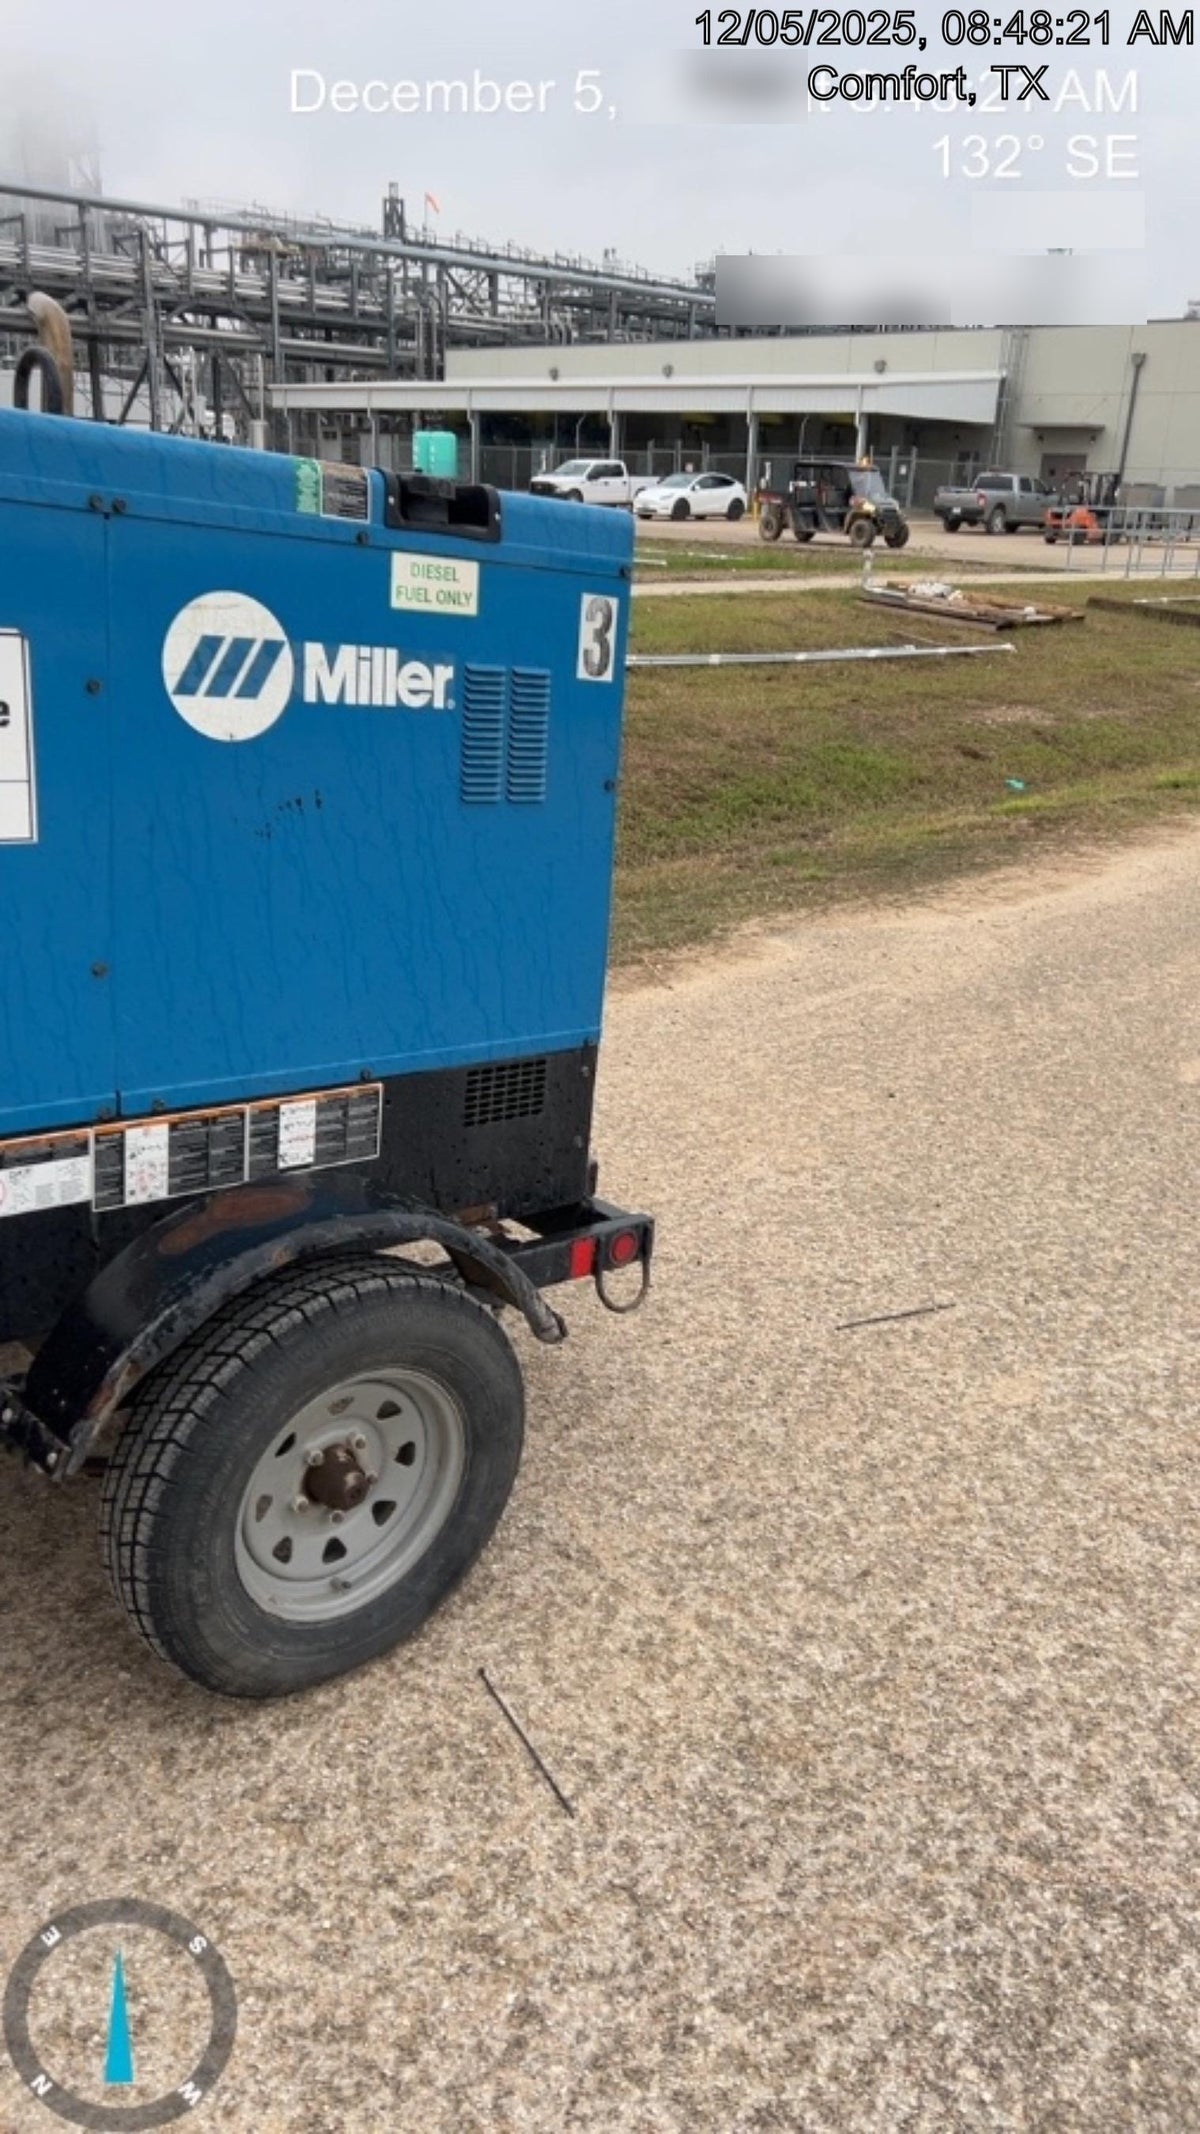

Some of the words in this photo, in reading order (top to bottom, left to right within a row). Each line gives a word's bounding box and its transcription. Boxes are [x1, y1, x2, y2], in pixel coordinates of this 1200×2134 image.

[409, 562, 460, 582] DIESEL
[395, 585, 433, 603] FUEL
[436, 589, 473, 607] ONLY
[583, 596, 613, 677] 3
[303, 641, 454, 710] Miller
